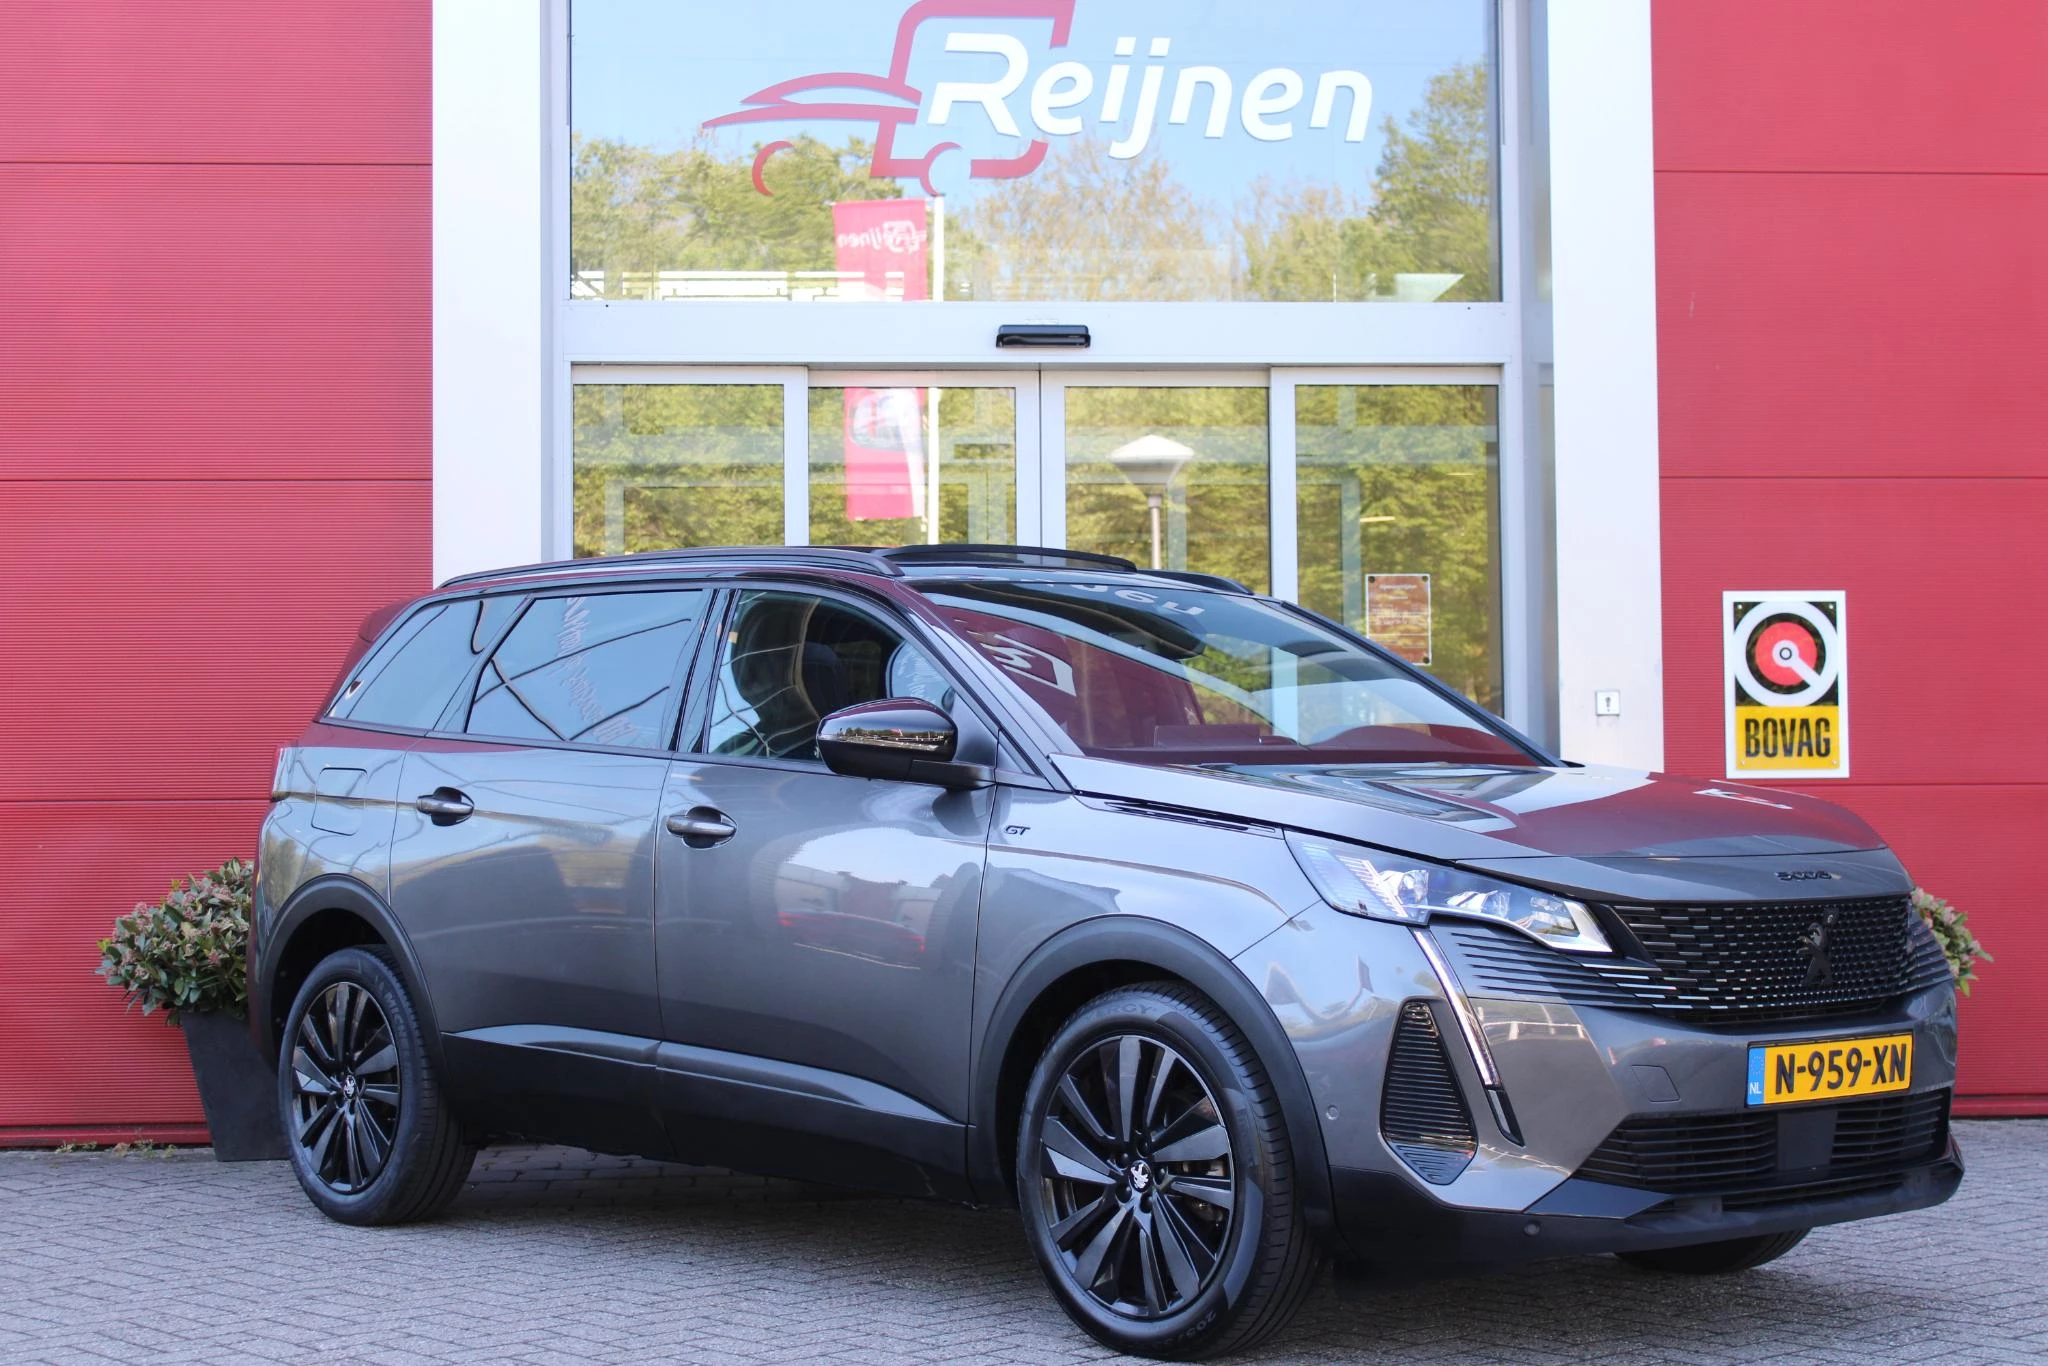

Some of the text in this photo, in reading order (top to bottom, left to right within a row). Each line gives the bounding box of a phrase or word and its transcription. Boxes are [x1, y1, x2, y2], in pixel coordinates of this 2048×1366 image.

[927, 32, 1373, 160] Reijnen
[1744, 717, 1832, 758] BOVAG
[1005, 825, 1031, 836] GT
[1750, 1081, 1762, 1095] NL
[1775, 1043, 1907, 1095] N-959-XN
